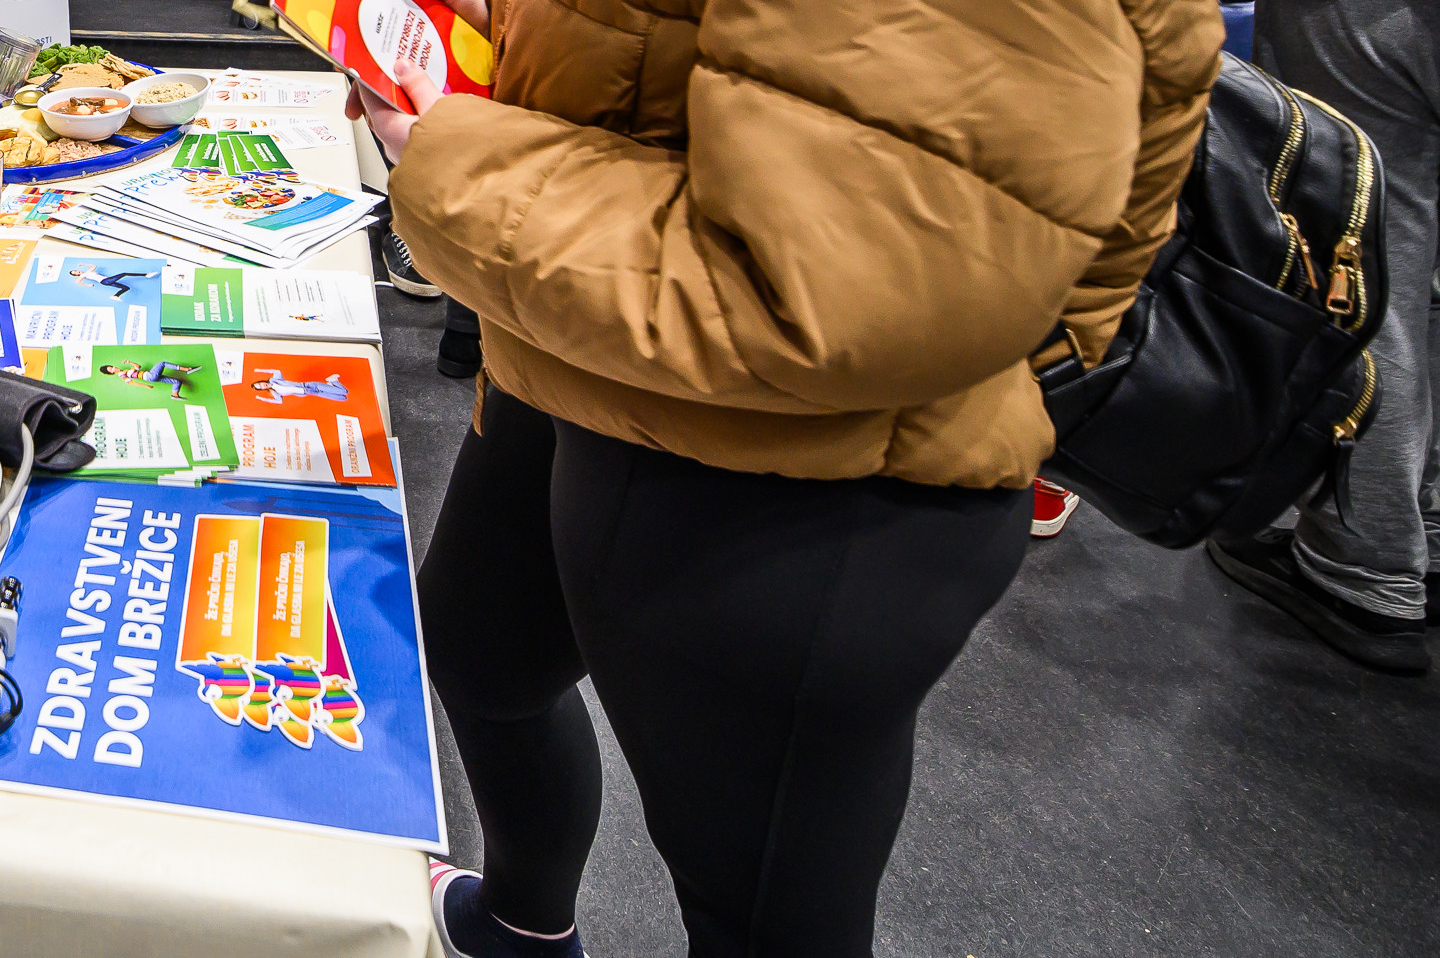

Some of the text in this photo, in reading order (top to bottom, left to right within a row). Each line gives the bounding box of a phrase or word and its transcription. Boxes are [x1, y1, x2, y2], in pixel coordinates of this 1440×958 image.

[94, 417, 107, 459] PROGRAM
[115, 438, 128, 459] HOJE
[242, 424, 256, 467] PROGRAM
[344, 420, 357, 447] PROGRAM
[263, 446, 277, 469] HOJE
[117, 509, 182, 650] BREŽICE
[28, 497, 134, 760] ZDRAVSTVENI
[93, 656, 158, 768] DOM
